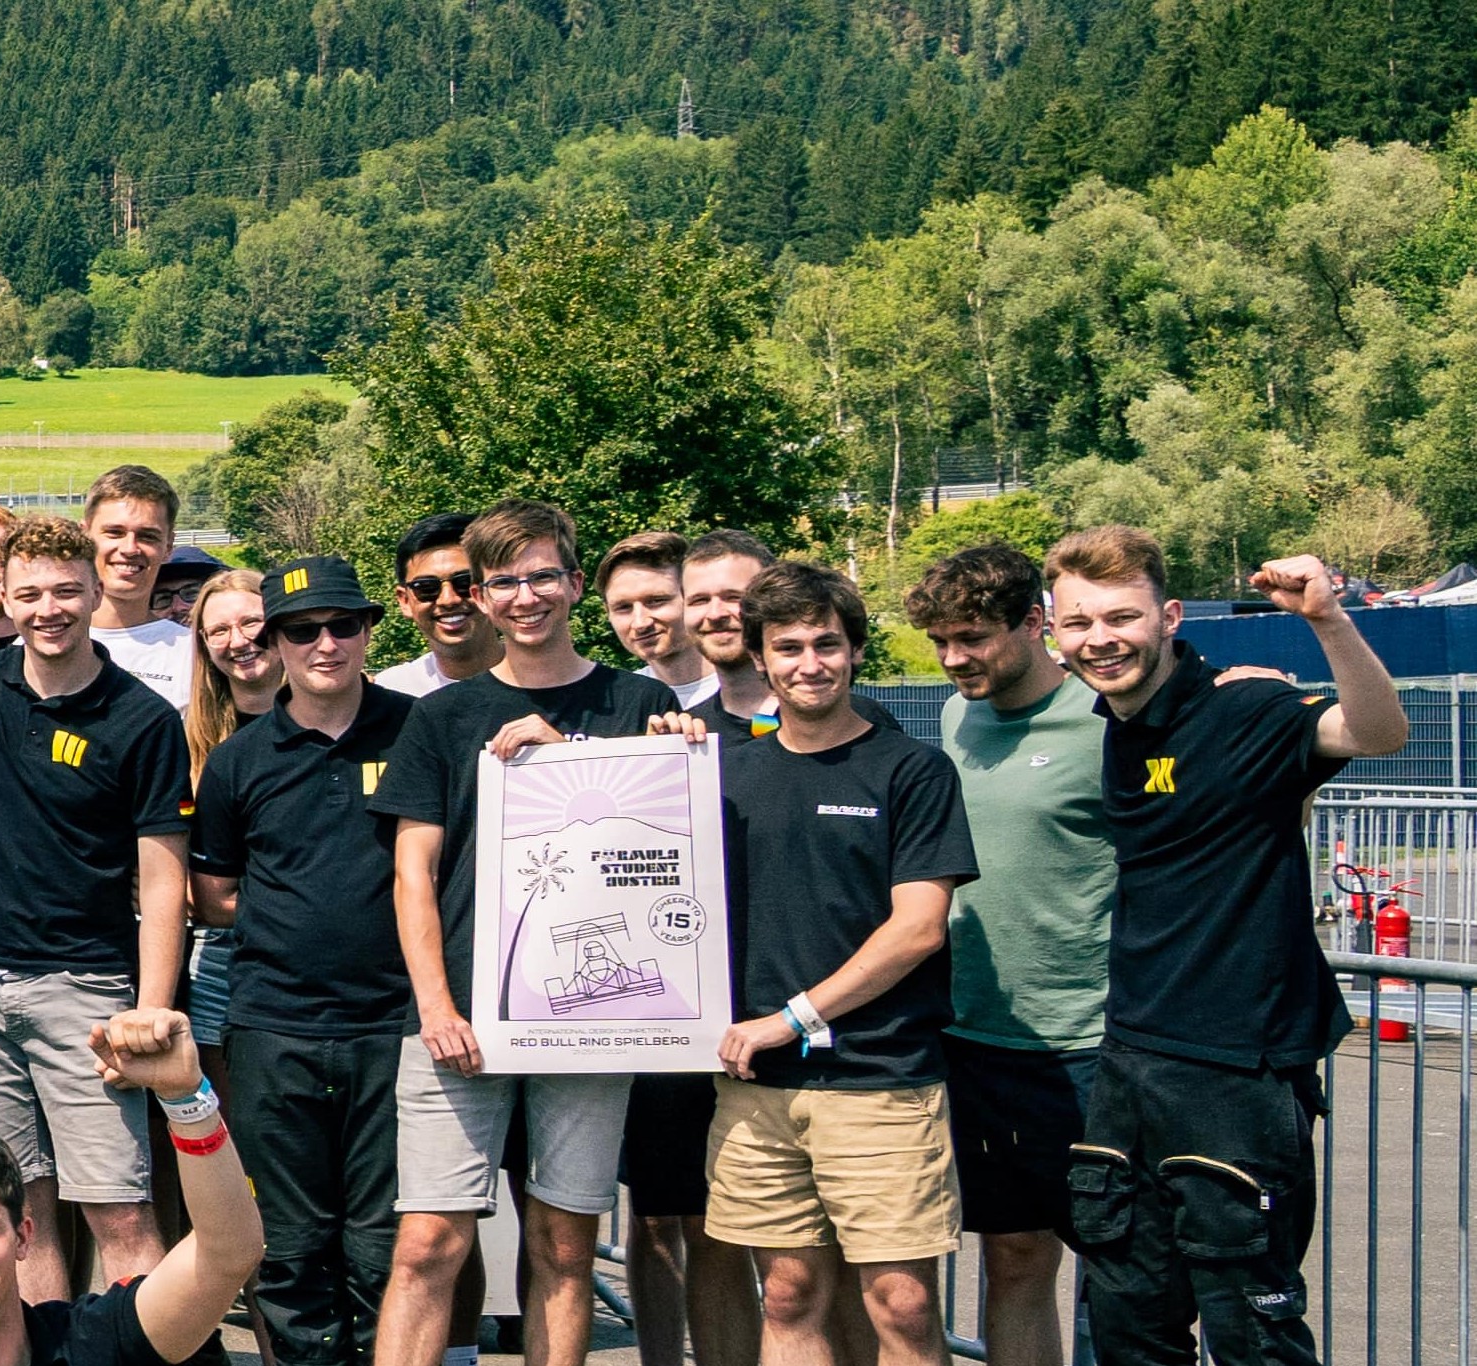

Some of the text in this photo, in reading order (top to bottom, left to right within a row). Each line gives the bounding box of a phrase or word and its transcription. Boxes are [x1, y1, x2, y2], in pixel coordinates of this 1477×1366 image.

[600, 862, 679, 874] STUDENT
[664, 912, 690, 929] 15
[510, 1037, 690, 1046] RED BULL RING SPIELBERG
